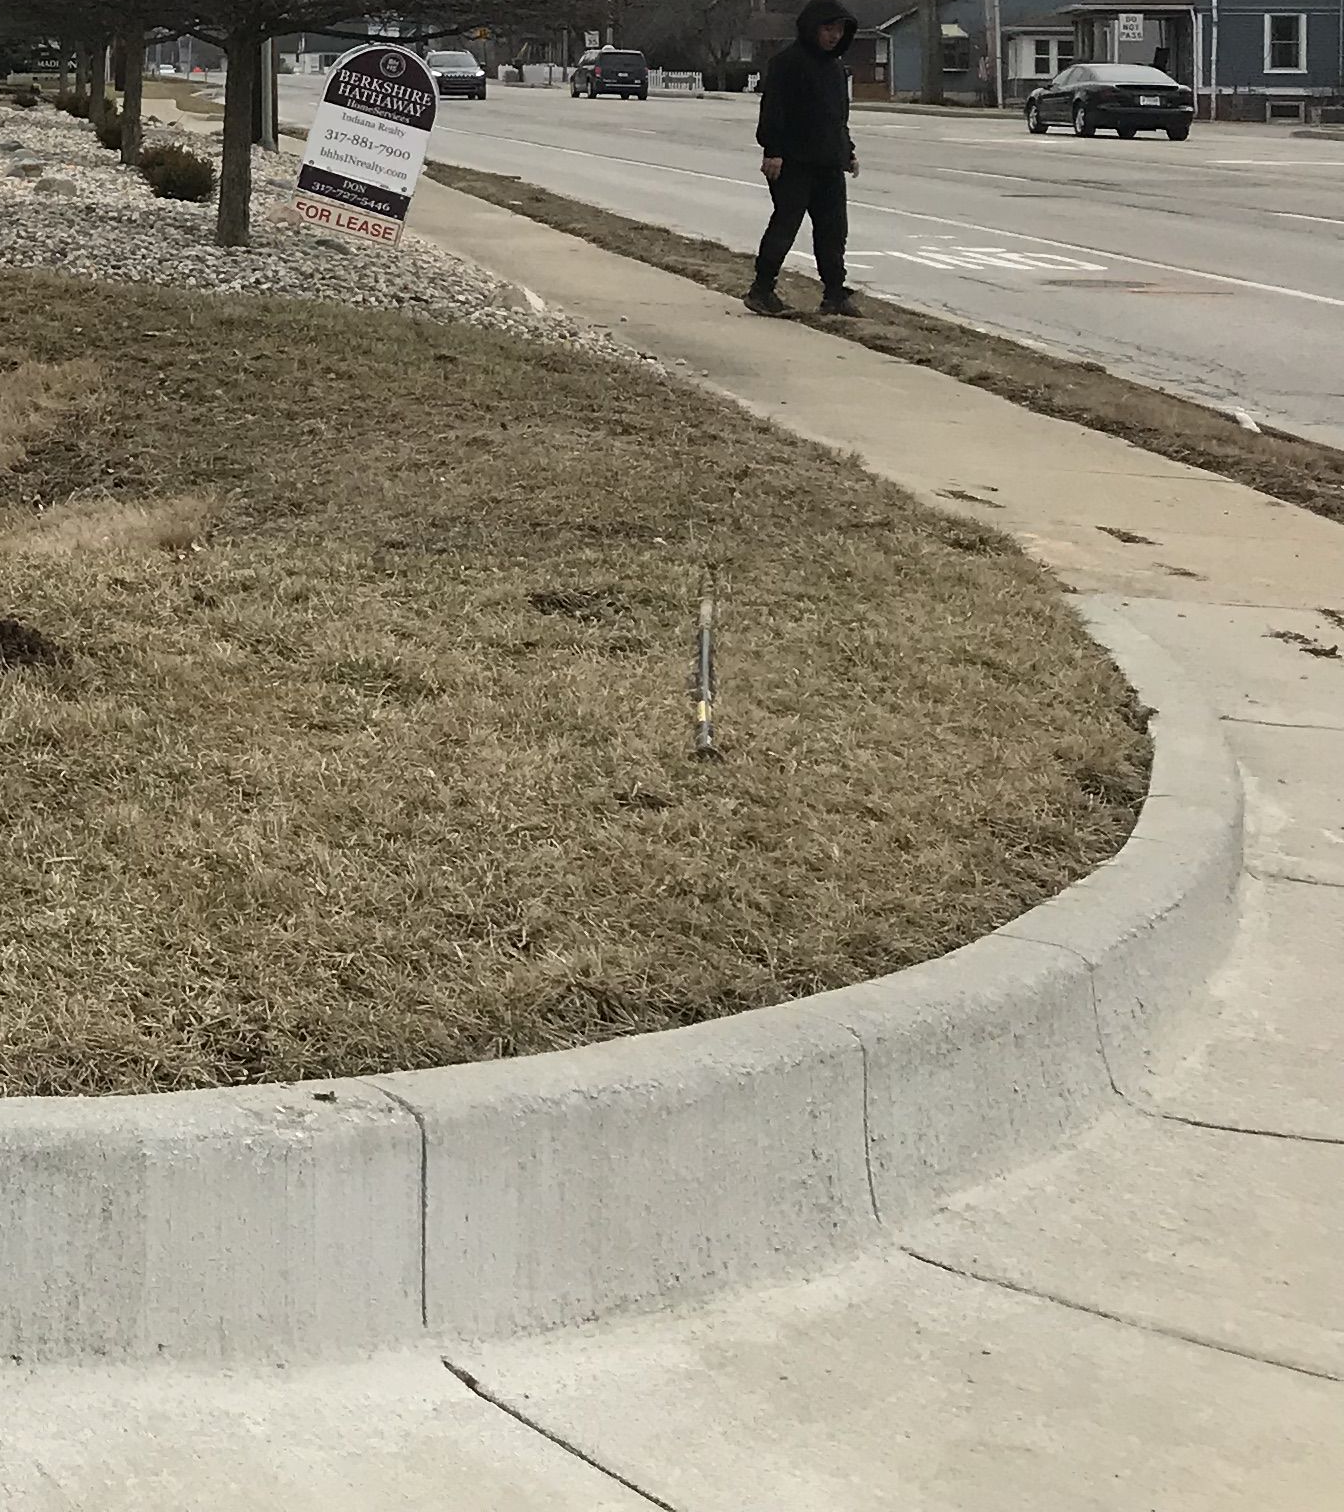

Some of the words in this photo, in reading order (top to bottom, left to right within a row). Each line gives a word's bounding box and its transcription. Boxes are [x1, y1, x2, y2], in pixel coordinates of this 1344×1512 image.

[338, 83, 425, 117] HATHAWAY
[339, 69, 432, 106] BERKSHIRE
[342, 112, 376, 129] Indiana
[378, 122, 406, 137] Realty
[347, 99, 410, 123] HomeServices
[324, 129, 411, 160] 317-881-7900
[320, 147, 408, 180] bhhsINrealty.com
[312, 182, 391, 211] 317-727-5446
[343, 180, 367, 193] DON
[335, 213, 395, 241] LEASE
